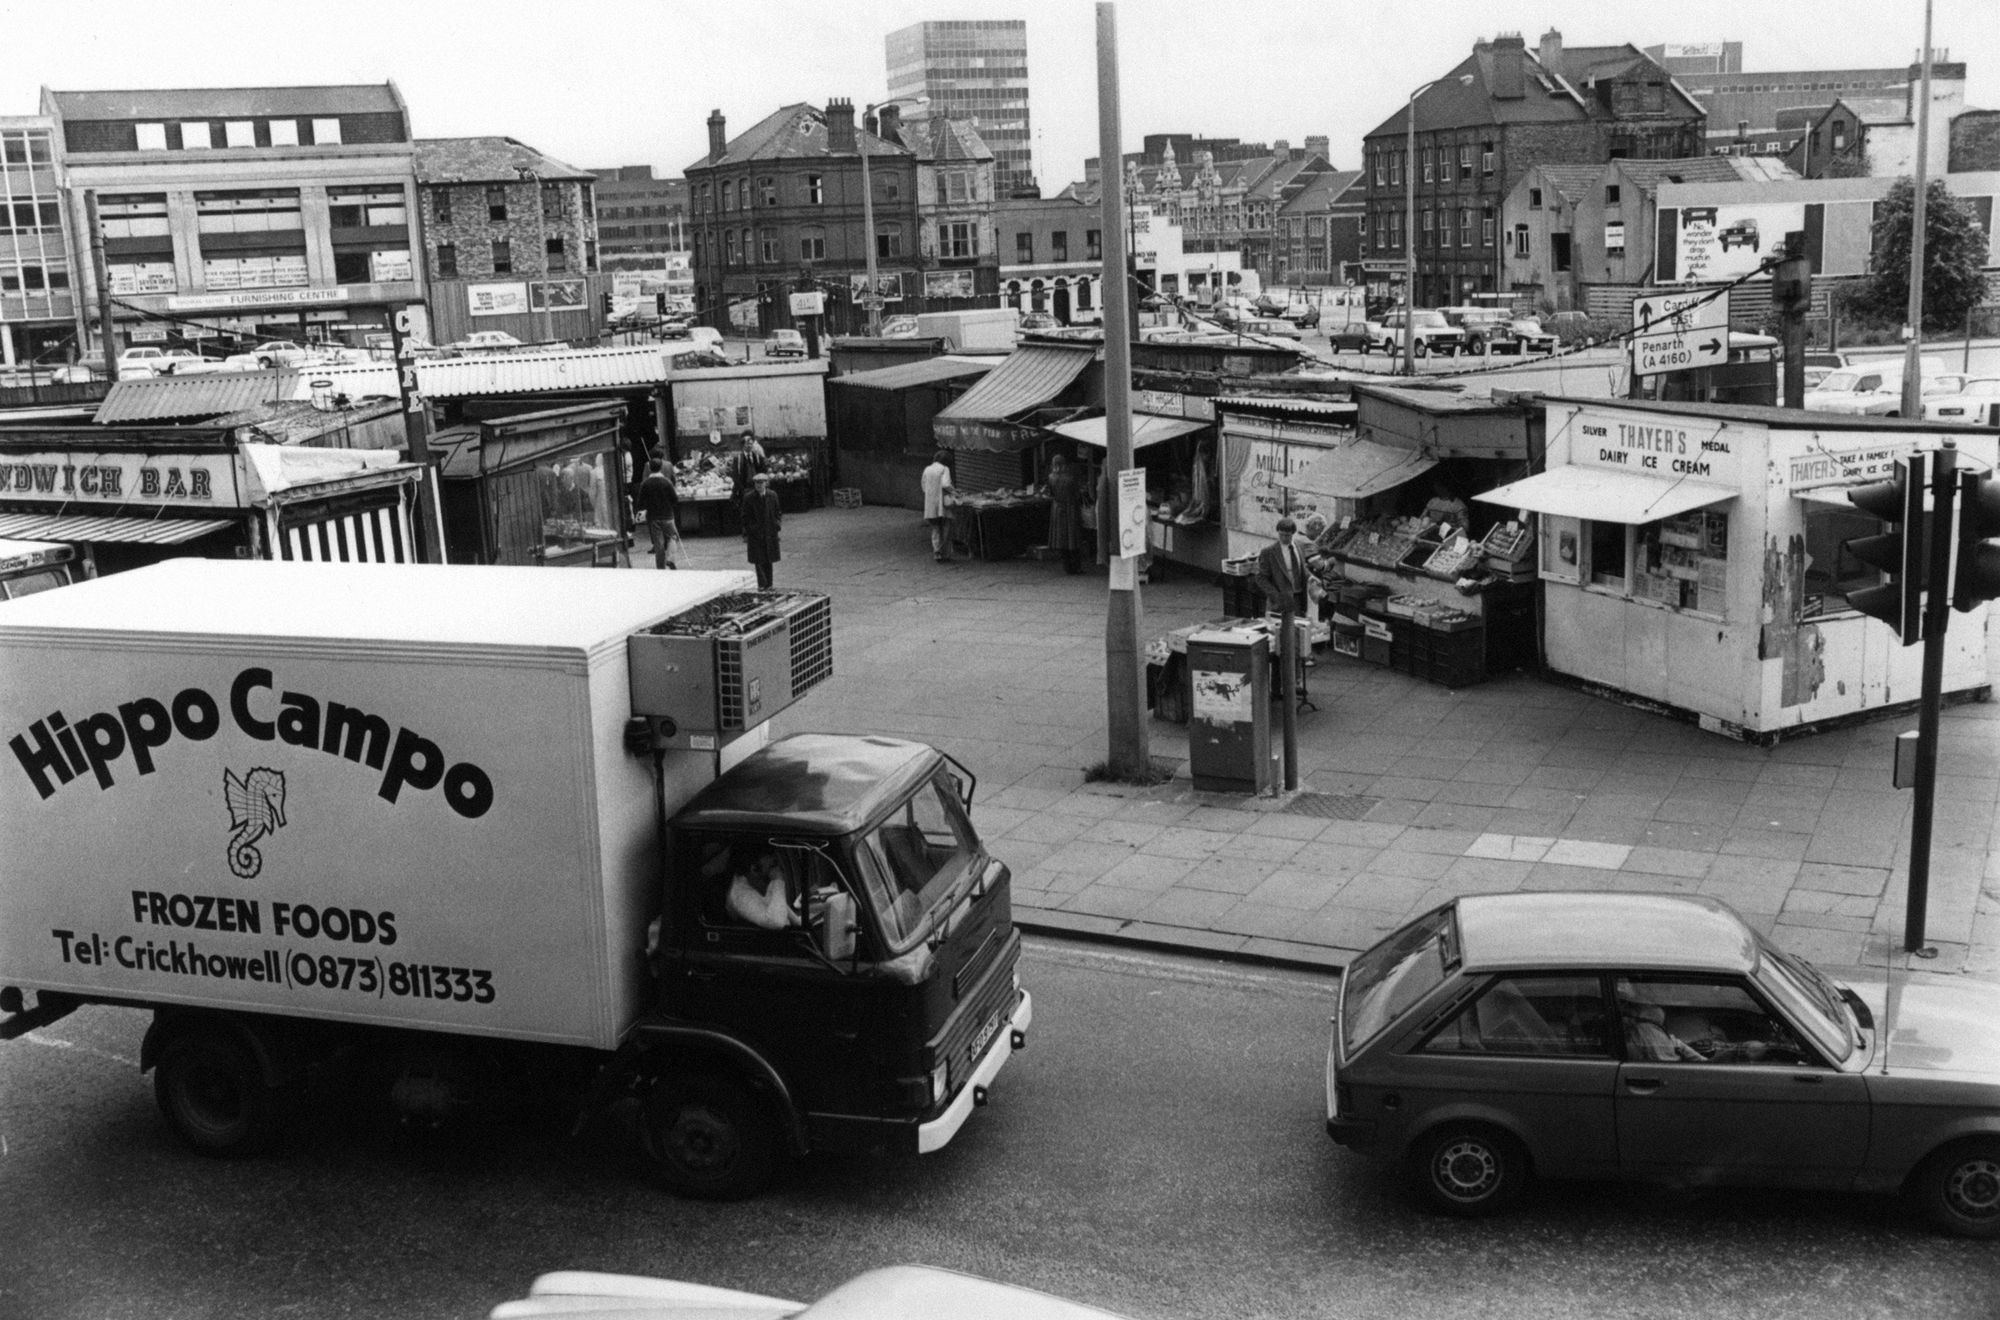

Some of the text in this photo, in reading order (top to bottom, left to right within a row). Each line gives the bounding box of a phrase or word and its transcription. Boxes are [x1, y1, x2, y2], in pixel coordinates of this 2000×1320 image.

[230, 292, 294, 304] FURNISHING
[299, 290, 337, 300] CENTRE
[1663, 297, 1699, 311] Cardiff
[1671, 313, 1693, 325] East
[1642, 339, 1684, 352] Penarth
[396, 310, 424, 413] CAFE
[1643, 350, 1692, 368] (A 4160)
[1582, 424, 1730, 454] SILVER THAYER'S MEDAL
[1256, 454, 1285, 474] MILL
[1600, 449, 1710, 476] DAIRY ICE CREAM
[1839, 454, 1856, 465] TAKE
[1858, 454, 1864, 463] A
[1866, 451, 1889, 461] FAMILY
[1842, 463, 1894, 478] DAIRY ICE CRE
[140, 466, 212, 499] BAR
[8, 667, 494, 819] Hippo Campo
[131, 890, 397, 946] FROZEN FOODS
[52, 929, 496, 1004] Tel: Crickhowell (0873) 811333
